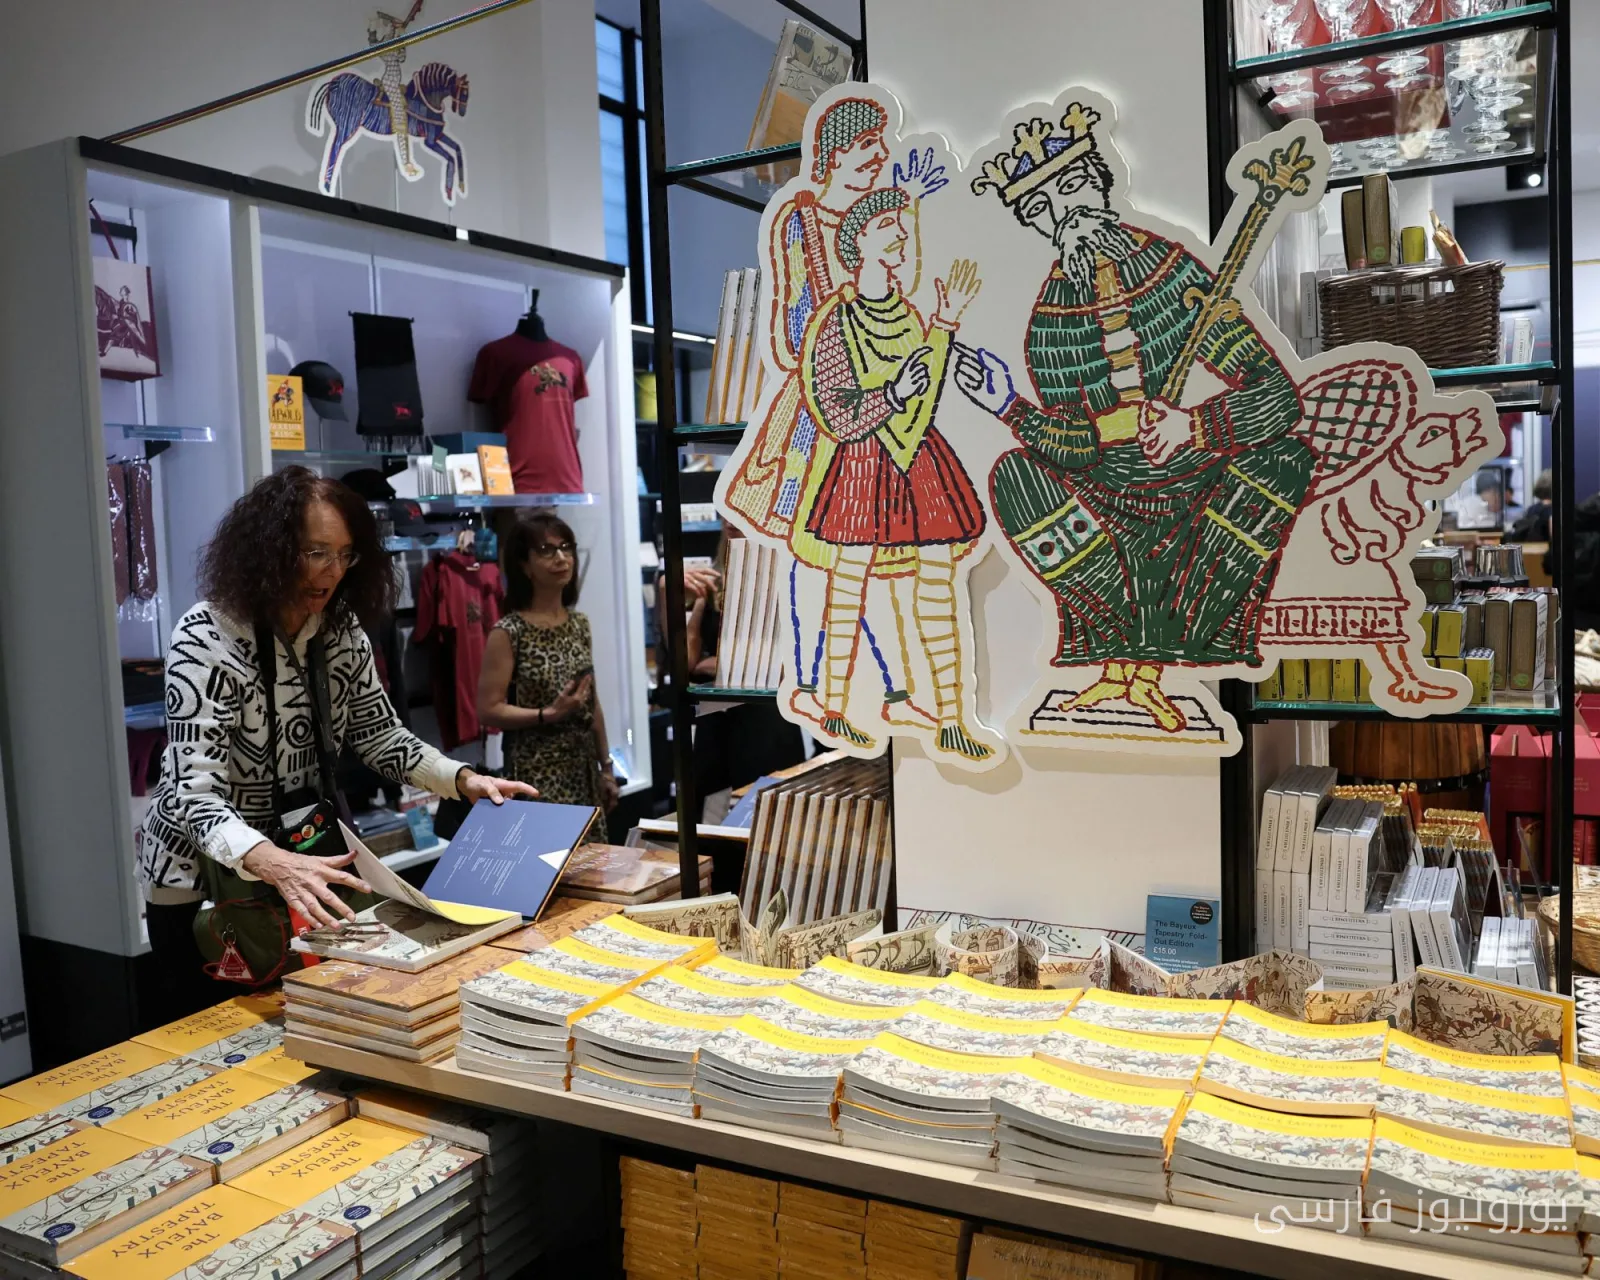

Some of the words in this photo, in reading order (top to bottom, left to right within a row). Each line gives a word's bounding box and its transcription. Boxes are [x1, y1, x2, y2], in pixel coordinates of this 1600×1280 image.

[1170, 921, 1196, 930] Bayeux
[1153, 947, 1176, 955] £15.00
[1169, 940, 1194, 948] Edition
[56, 1059, 126, 1086] BAYEUX
[90, 1072, 122, 1082] The
[143, 1081, 228, 1119] TAPESTRY
[164, 1088, 235, 1120] BAYEUX
[200, 1102, 232, 1114] The
[268, 1132, 352, 1176] TAPESTRY
[292, 1141, 362, 1178] BAYEUX
[329, 1157, 362, 1172] The
[4, 1151, 90, 1190] BAYEUX
[47, 1167, 85, 1183] The
[112, 1202, 215, 1258] TAPESTRY
[137, 1213, 223, 1258] BAYEUX
[182, 1233, 220, 1251] The
